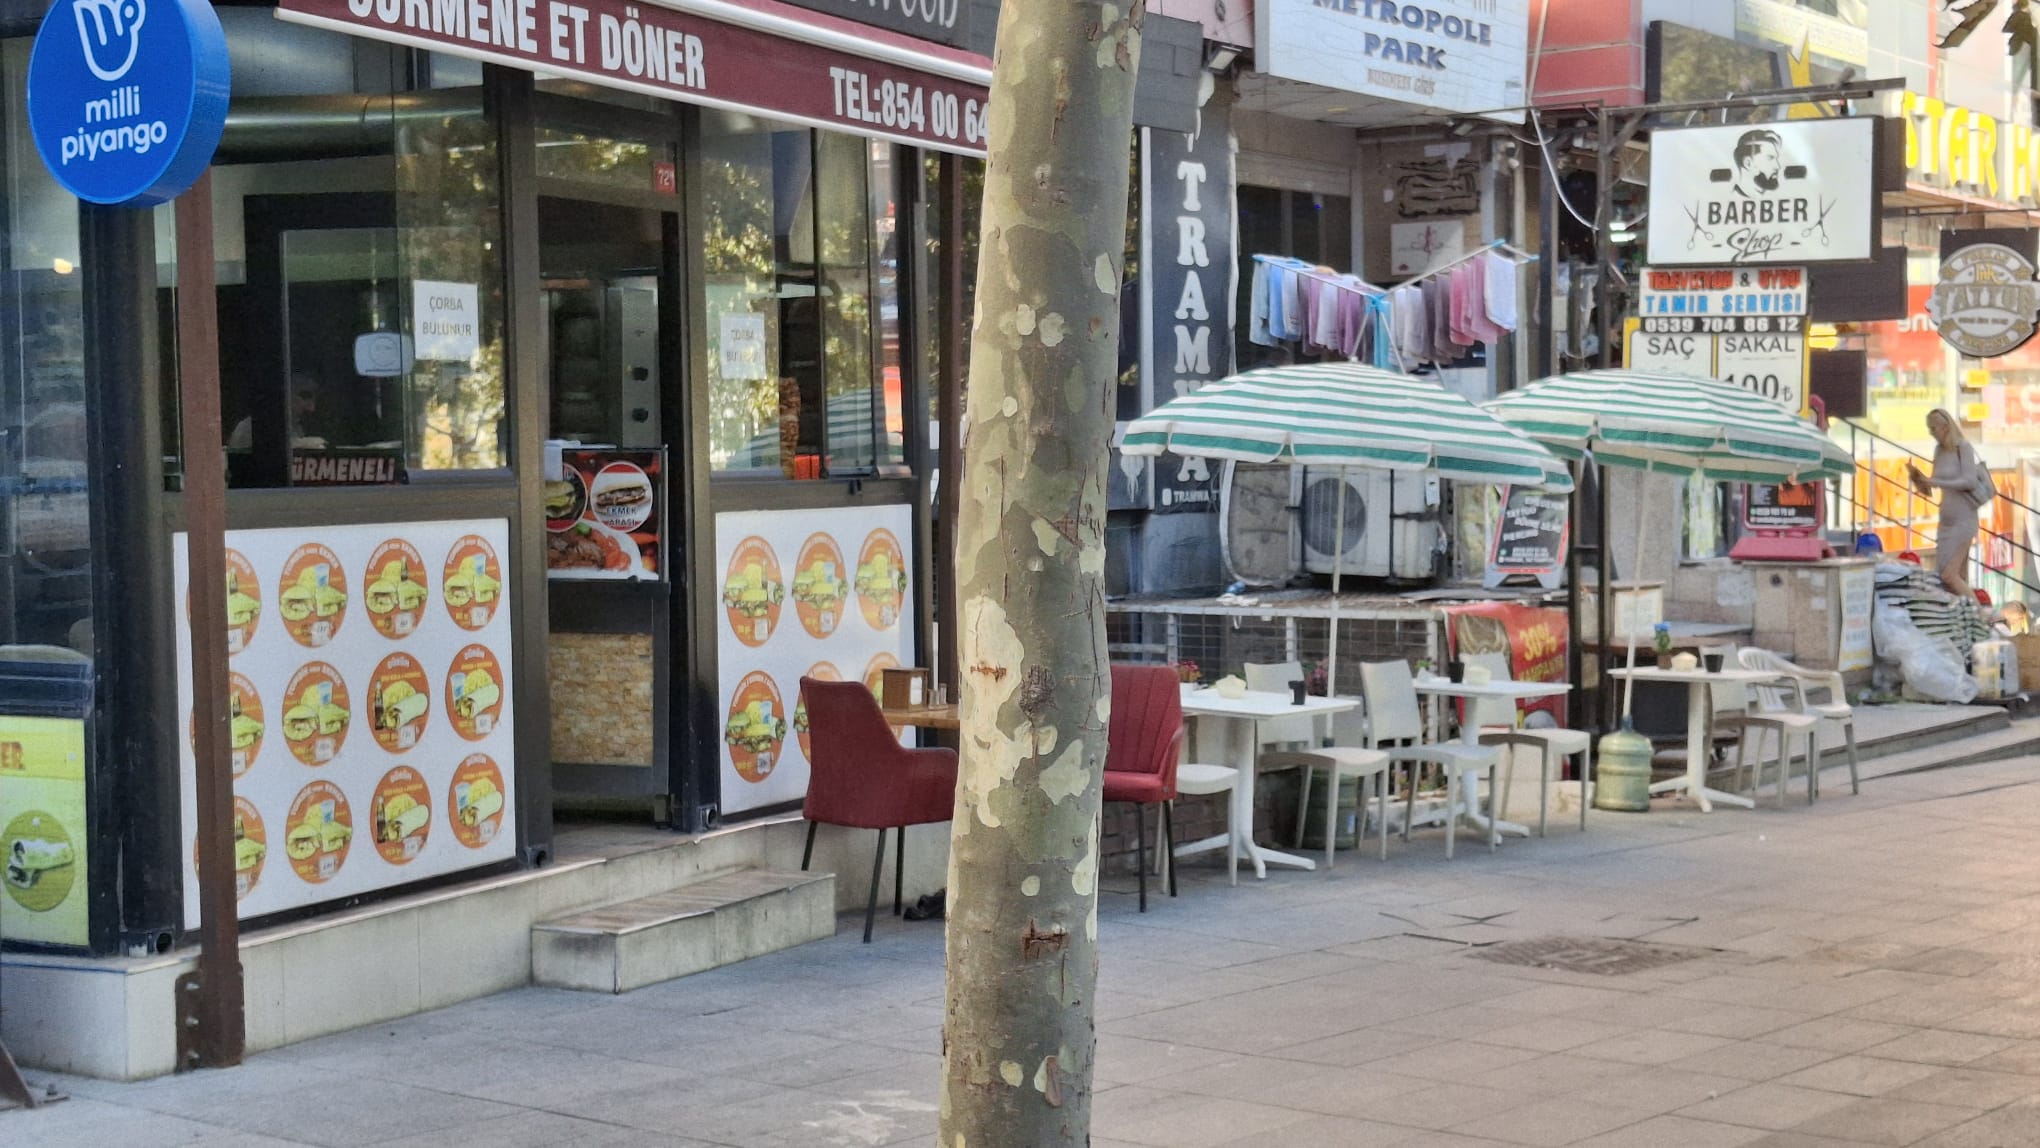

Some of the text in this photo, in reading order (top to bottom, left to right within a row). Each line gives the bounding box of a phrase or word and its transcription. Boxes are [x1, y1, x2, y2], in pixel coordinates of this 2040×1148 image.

[550, 1, 589, 64] ET
[600, 8, 707, 89] DÖNER
[1363, 32, 1447, 71] PARK
[85, 85, 140, 123] milli
[829, 66, 989, 145] TEL:854 00 64
[61, 120, 168, 166] piyango
[1708, 198, 1808, 225] BARBER
[1726, 227, 1783, 264] Shop
[1740, 272, 1750, 287] &
[429, 296, 464, 312] ÇORBA
[422, 321, 472, 337] BULUNUR
[1645, 316, 1799, 332] 0539 704 86 12
[1648, 336, 1796, 360] SAÇ SAKAL
